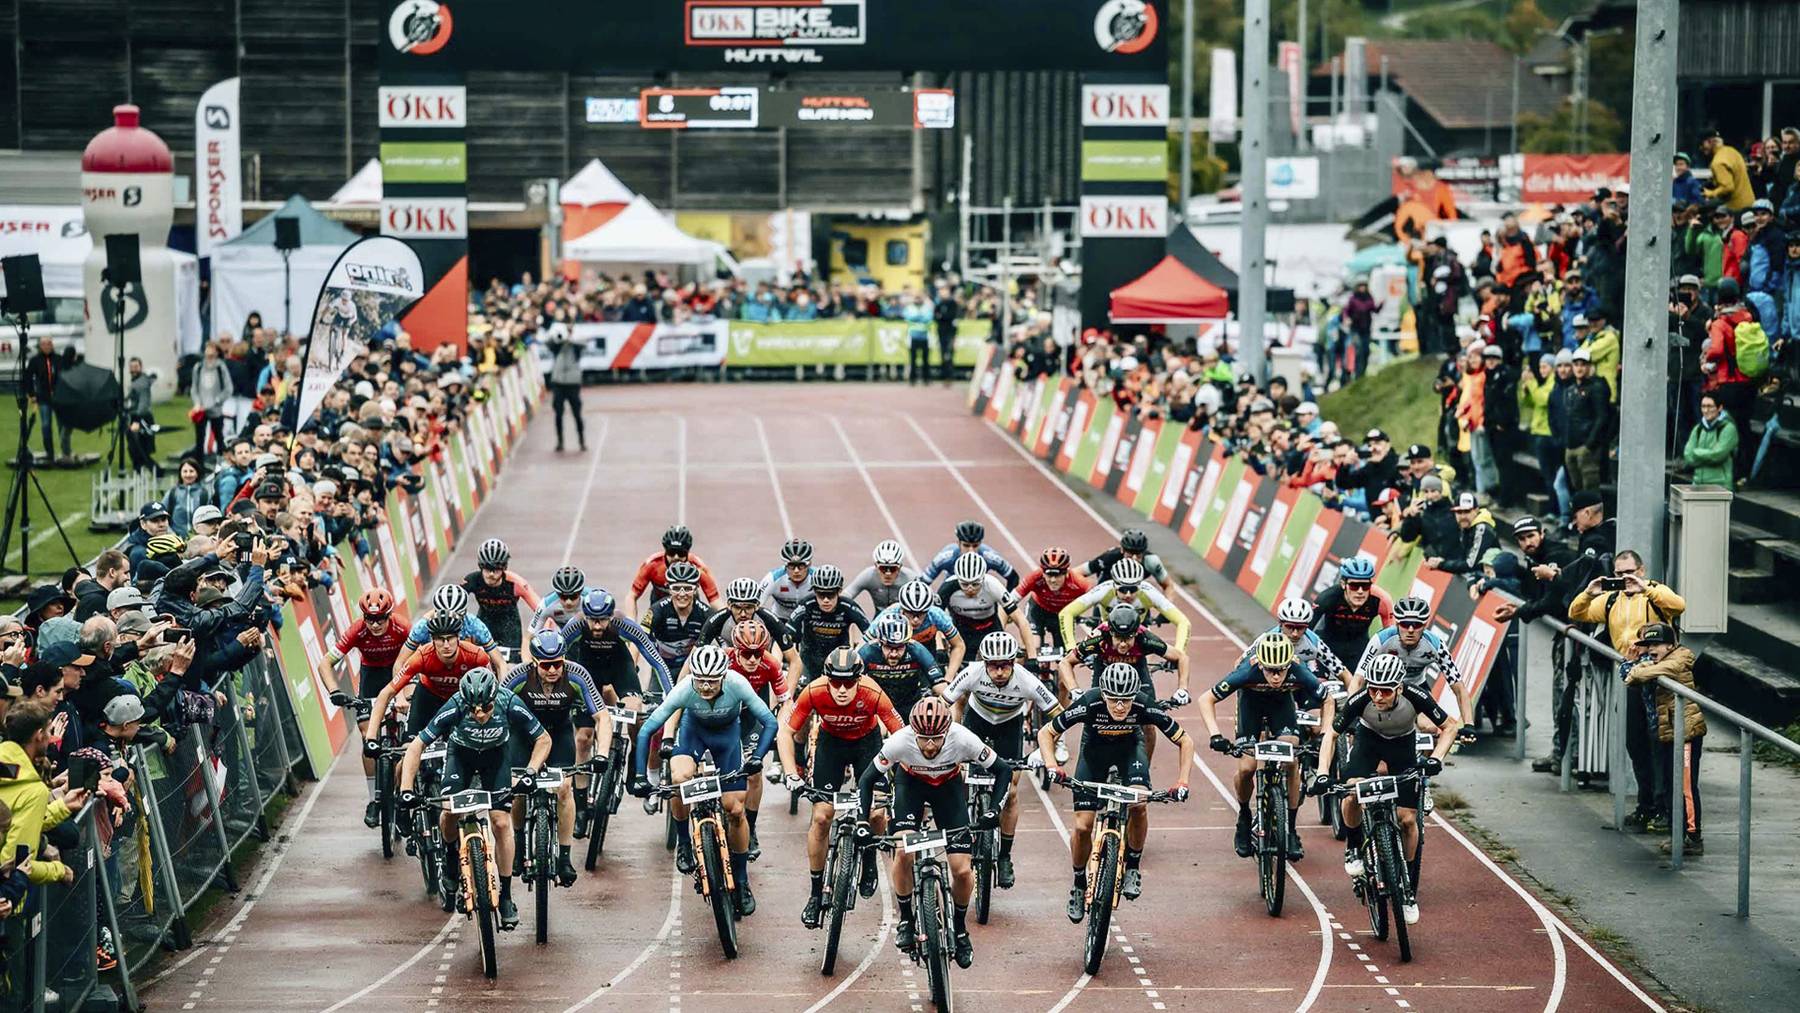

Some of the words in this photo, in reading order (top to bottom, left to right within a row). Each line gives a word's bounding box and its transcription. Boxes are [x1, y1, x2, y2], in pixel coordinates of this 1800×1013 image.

[756, 8, 832, 27] BIKE
[387, 93, 456, 120] ÖKK
[1090, 92, 1159, 119] ÖKK
[83, 187, 116, 201] NSER
[208, 142, 228, 240] SPONSER
[388, 204, 457, 232] ÖKK
[1089, 203, 1157, 230] ÖKK
[976, 690, 1025, 702] SCOTT
[823, 714, 869, 723] BMC
[693, 781, 708, 792] 14
[1369, 781, 1384, 792] 11
[466, 794, 475, 803] 7
